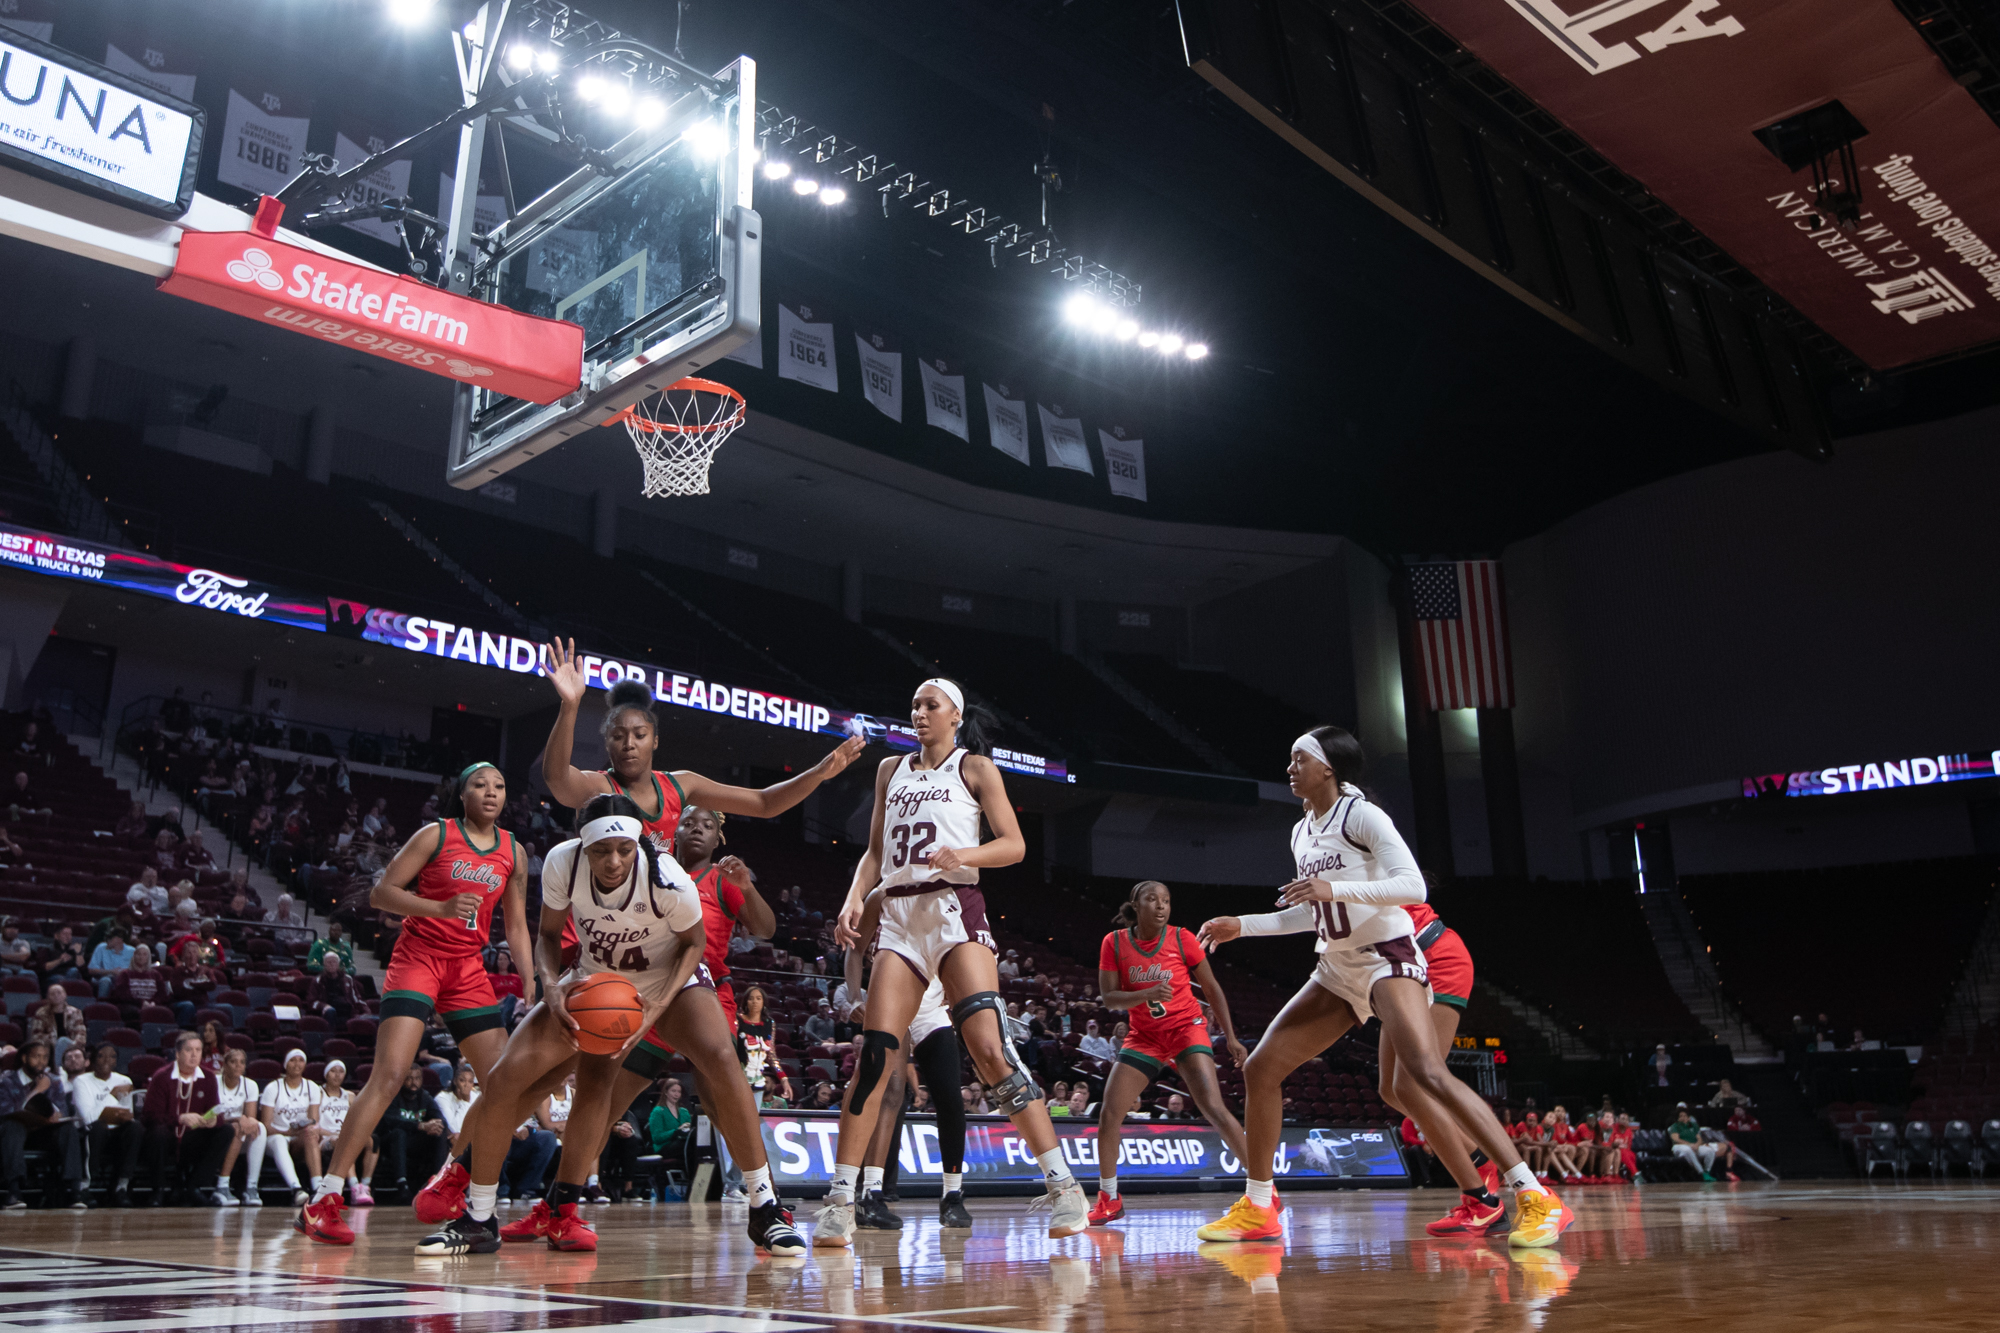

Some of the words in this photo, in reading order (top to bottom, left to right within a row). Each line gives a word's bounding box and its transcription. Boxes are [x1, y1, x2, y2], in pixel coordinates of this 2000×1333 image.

[40, 135, 126, 174] freshener
[237, 136, 290, 175] 1986
[1807, 178, 1921, 268] CAMS
[1907, 192, 1953, 227] love
[1766, 190, 1885, 277] AMERICAN
[1931, 217, 1999, 268] students
[789, 340, 828, 368] 1964
[866, 368, 893, 398] 1951
[932, 391, 962, 419] 1923
[1105, 458, 1138, 481] 1920
[35, 540, 54, 558] IN
[56, 545, 106, 568] TEXAS
[36, 556, 71, 574] TRUCK
[71, 564, 82, 575] &
[82, 566, 104, 580] SUV
[175, 569, 269, 618] Ford
[404, 616, 549, 677] STAND!
[656, 671, 830, 733] LEADERSHIP
[992, 747, 1011, 760] BEST
[1012, 751, 1022, 763] IN
[1022, 753, 1046, 767] TEXAS
[1820, 755, 1950, 794] STAND!
[887, 785, 953, 818] Aggies
[891, 821, 937, 869] 32
[451, 860, 503, 893] Valley
[578, 917, 650, 952] Aggies
[1128, 963, 1173, 985] Valley
[1145, 999, 1167, 1019] 5
[1351, 1133, 1384, 1143] F-150
